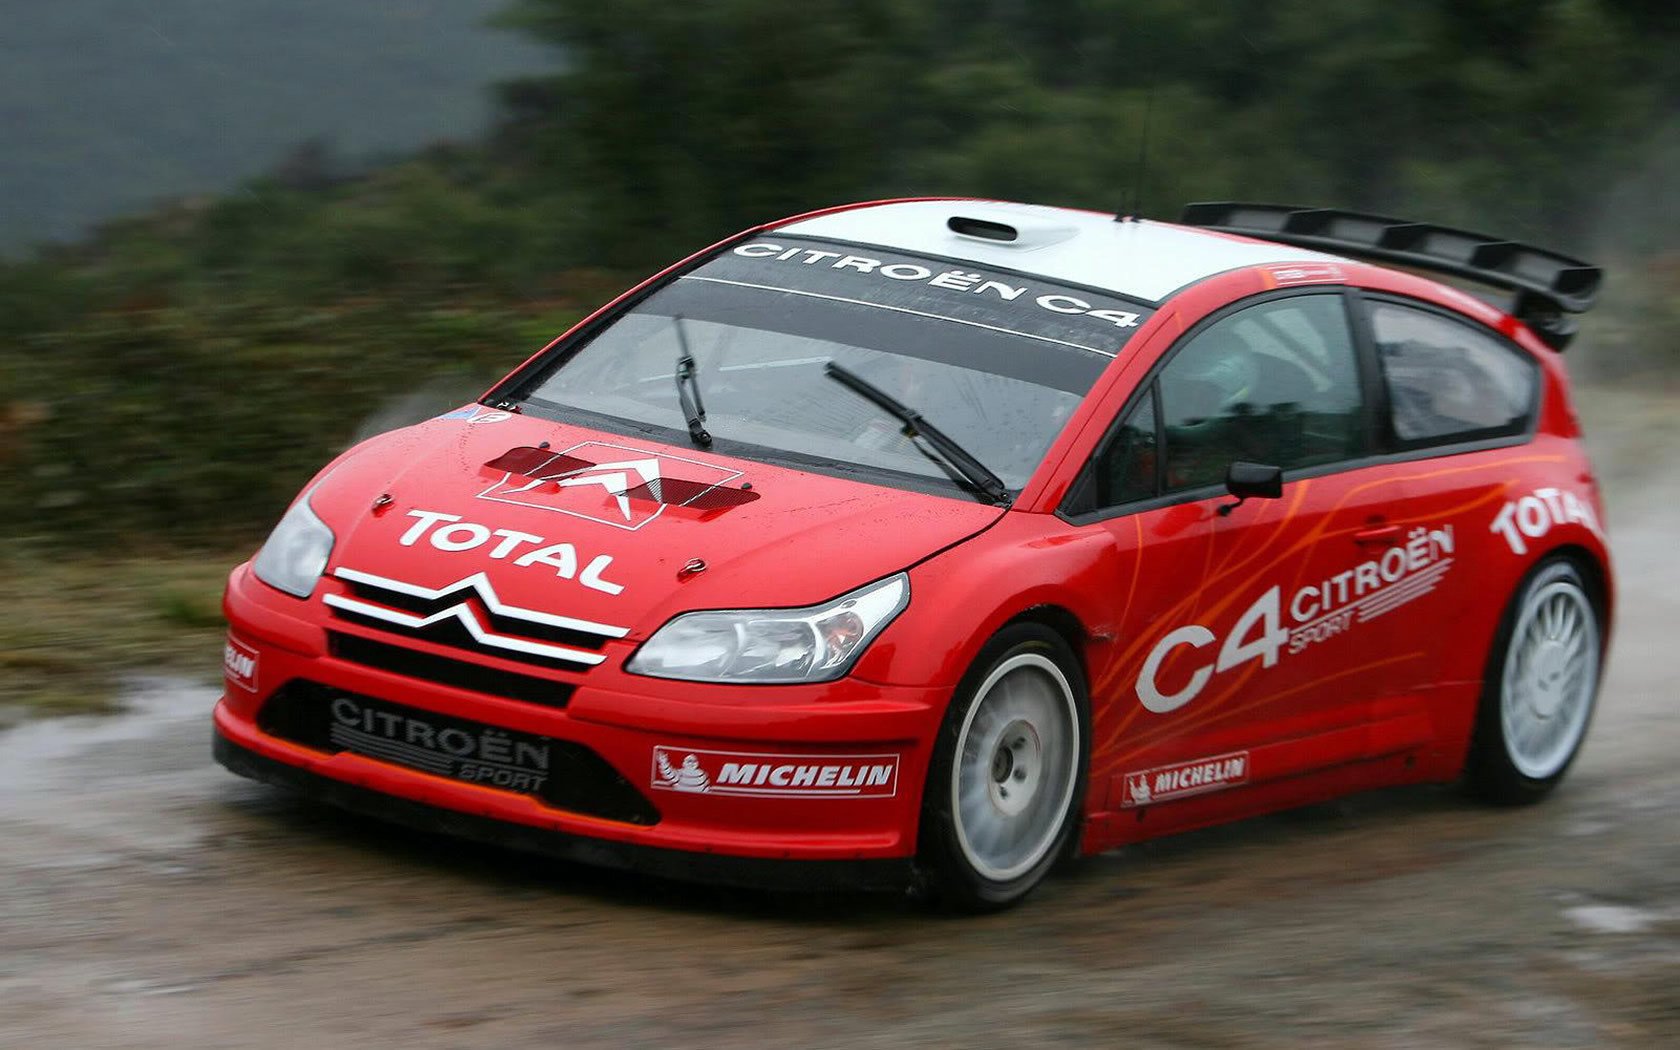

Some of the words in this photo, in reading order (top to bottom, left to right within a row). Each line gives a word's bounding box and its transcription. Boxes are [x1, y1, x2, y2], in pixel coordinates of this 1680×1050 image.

[732, 242, 1028, 302] CITROËN
[1036, 294, 1142, 329] C4
[400, 509, 626, 596] TOTAL
[1134, 584, 1289, 714] C4
[1290, 523, 1455, 633] CITROËN
[1288, 609, 1356, 654] SPORT
[331, 698, 550, 770] CITROËN
[459, 762, 548, 793] SPORT
[716, 762, 894, 787] MICHELIN
[1154, 756, 1246, 793] MICHELIN
